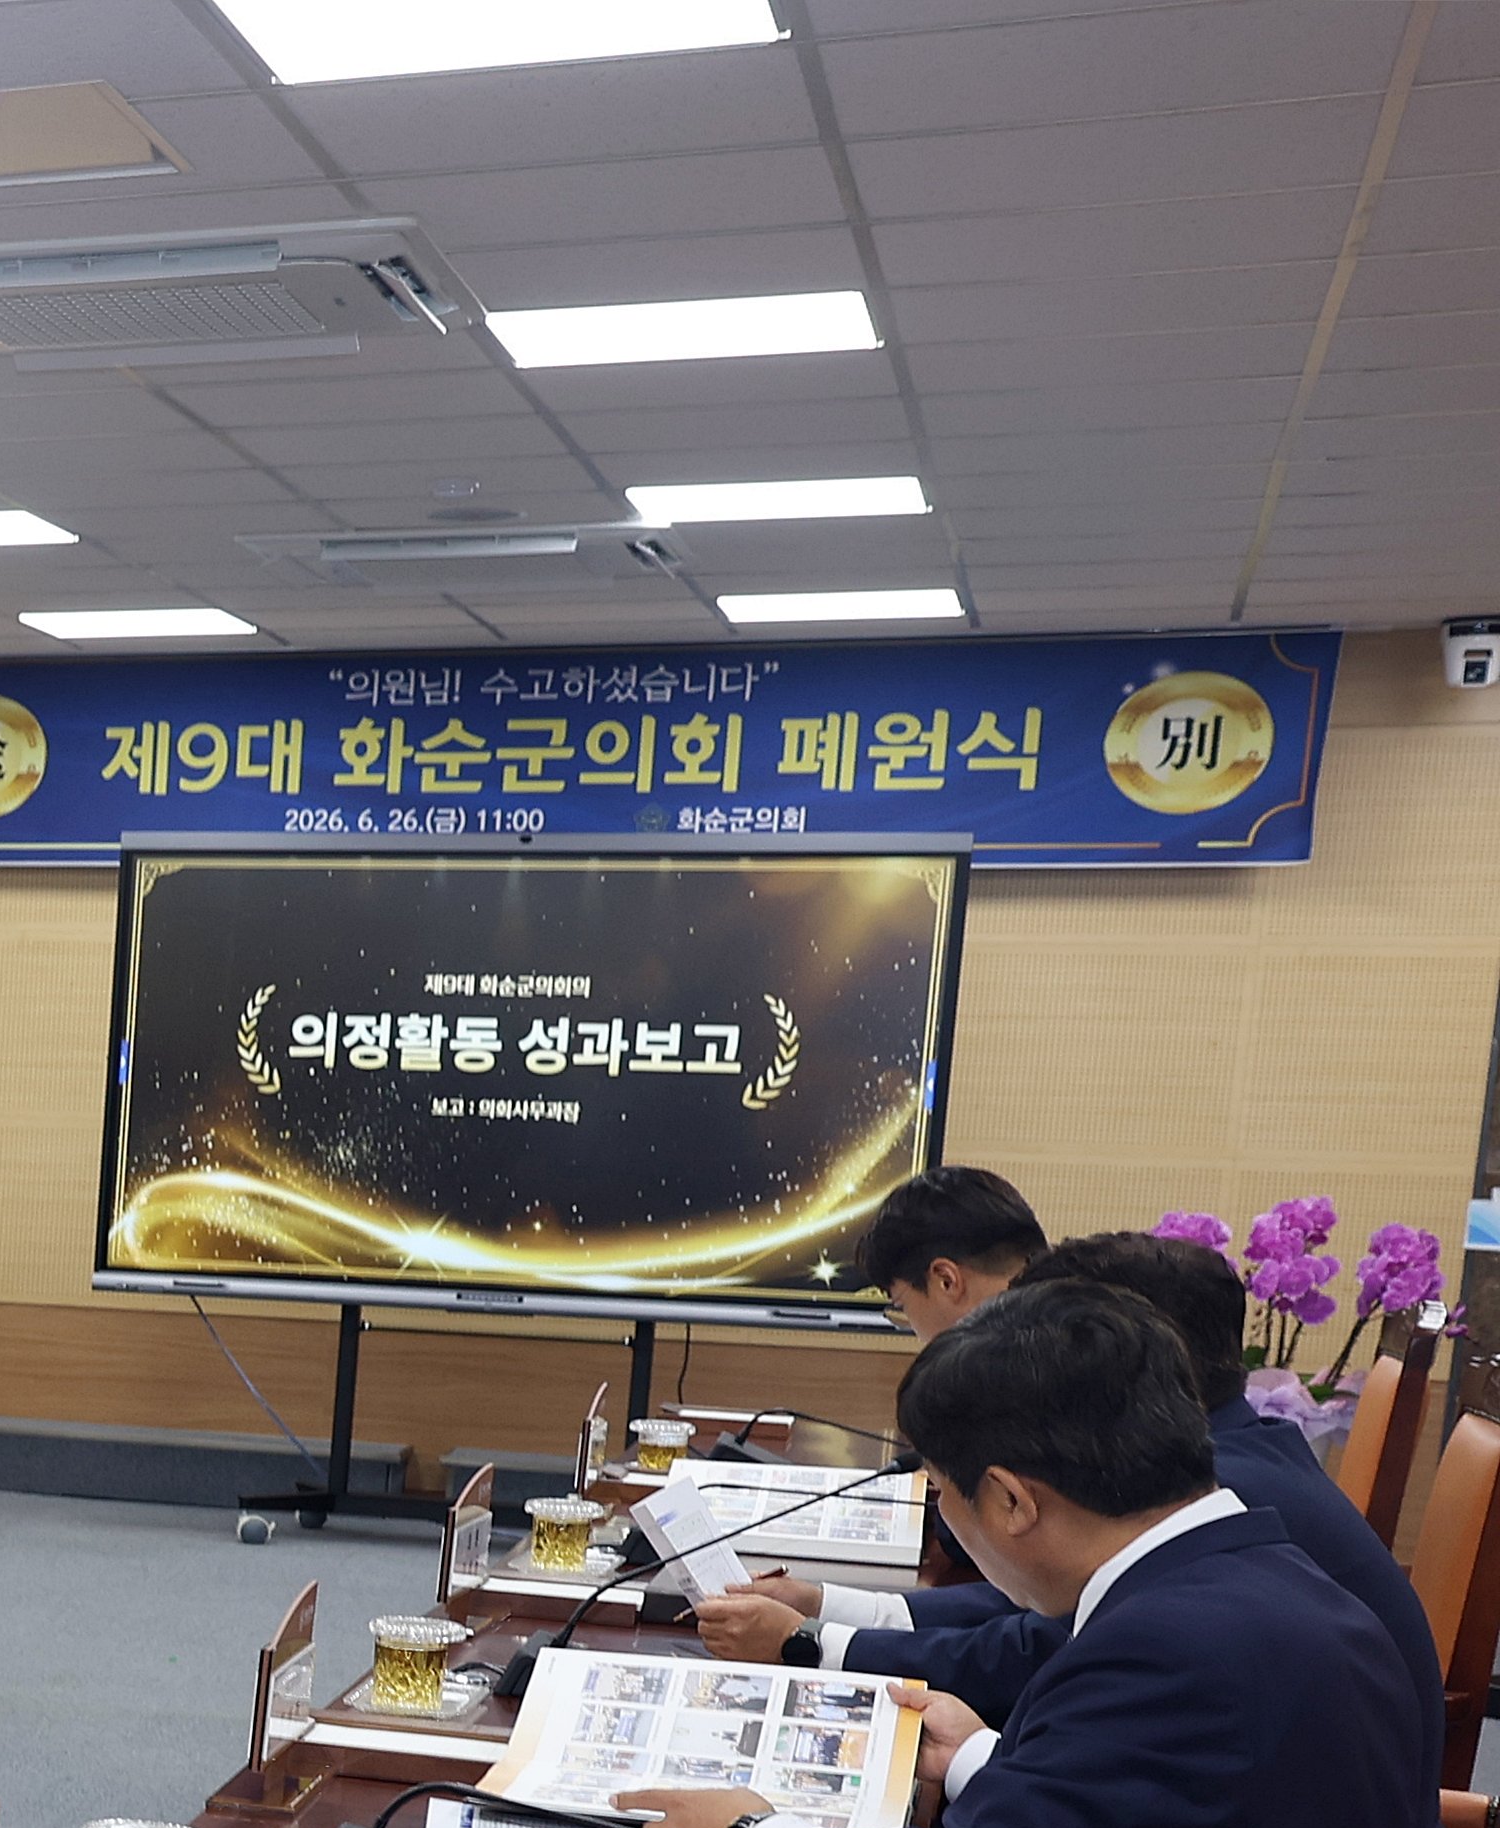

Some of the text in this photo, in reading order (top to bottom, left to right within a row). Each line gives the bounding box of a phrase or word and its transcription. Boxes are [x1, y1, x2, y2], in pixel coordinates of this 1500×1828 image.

[101, 706, 1043, 796] 제9대 화순군의회 폐원식
[1159, 706, 1223, 770] 別
[285, 808, 544, 833] 2026. 6. 26.(금) 11:00
[676, 806, 806, 833] 화순군의회
[424, 974, 592, 999] 제9대 화순군의회의
[289, 1011, 742, 1077] 의정활동 성과보고
[432, 1097, 465, 1117] 보고
